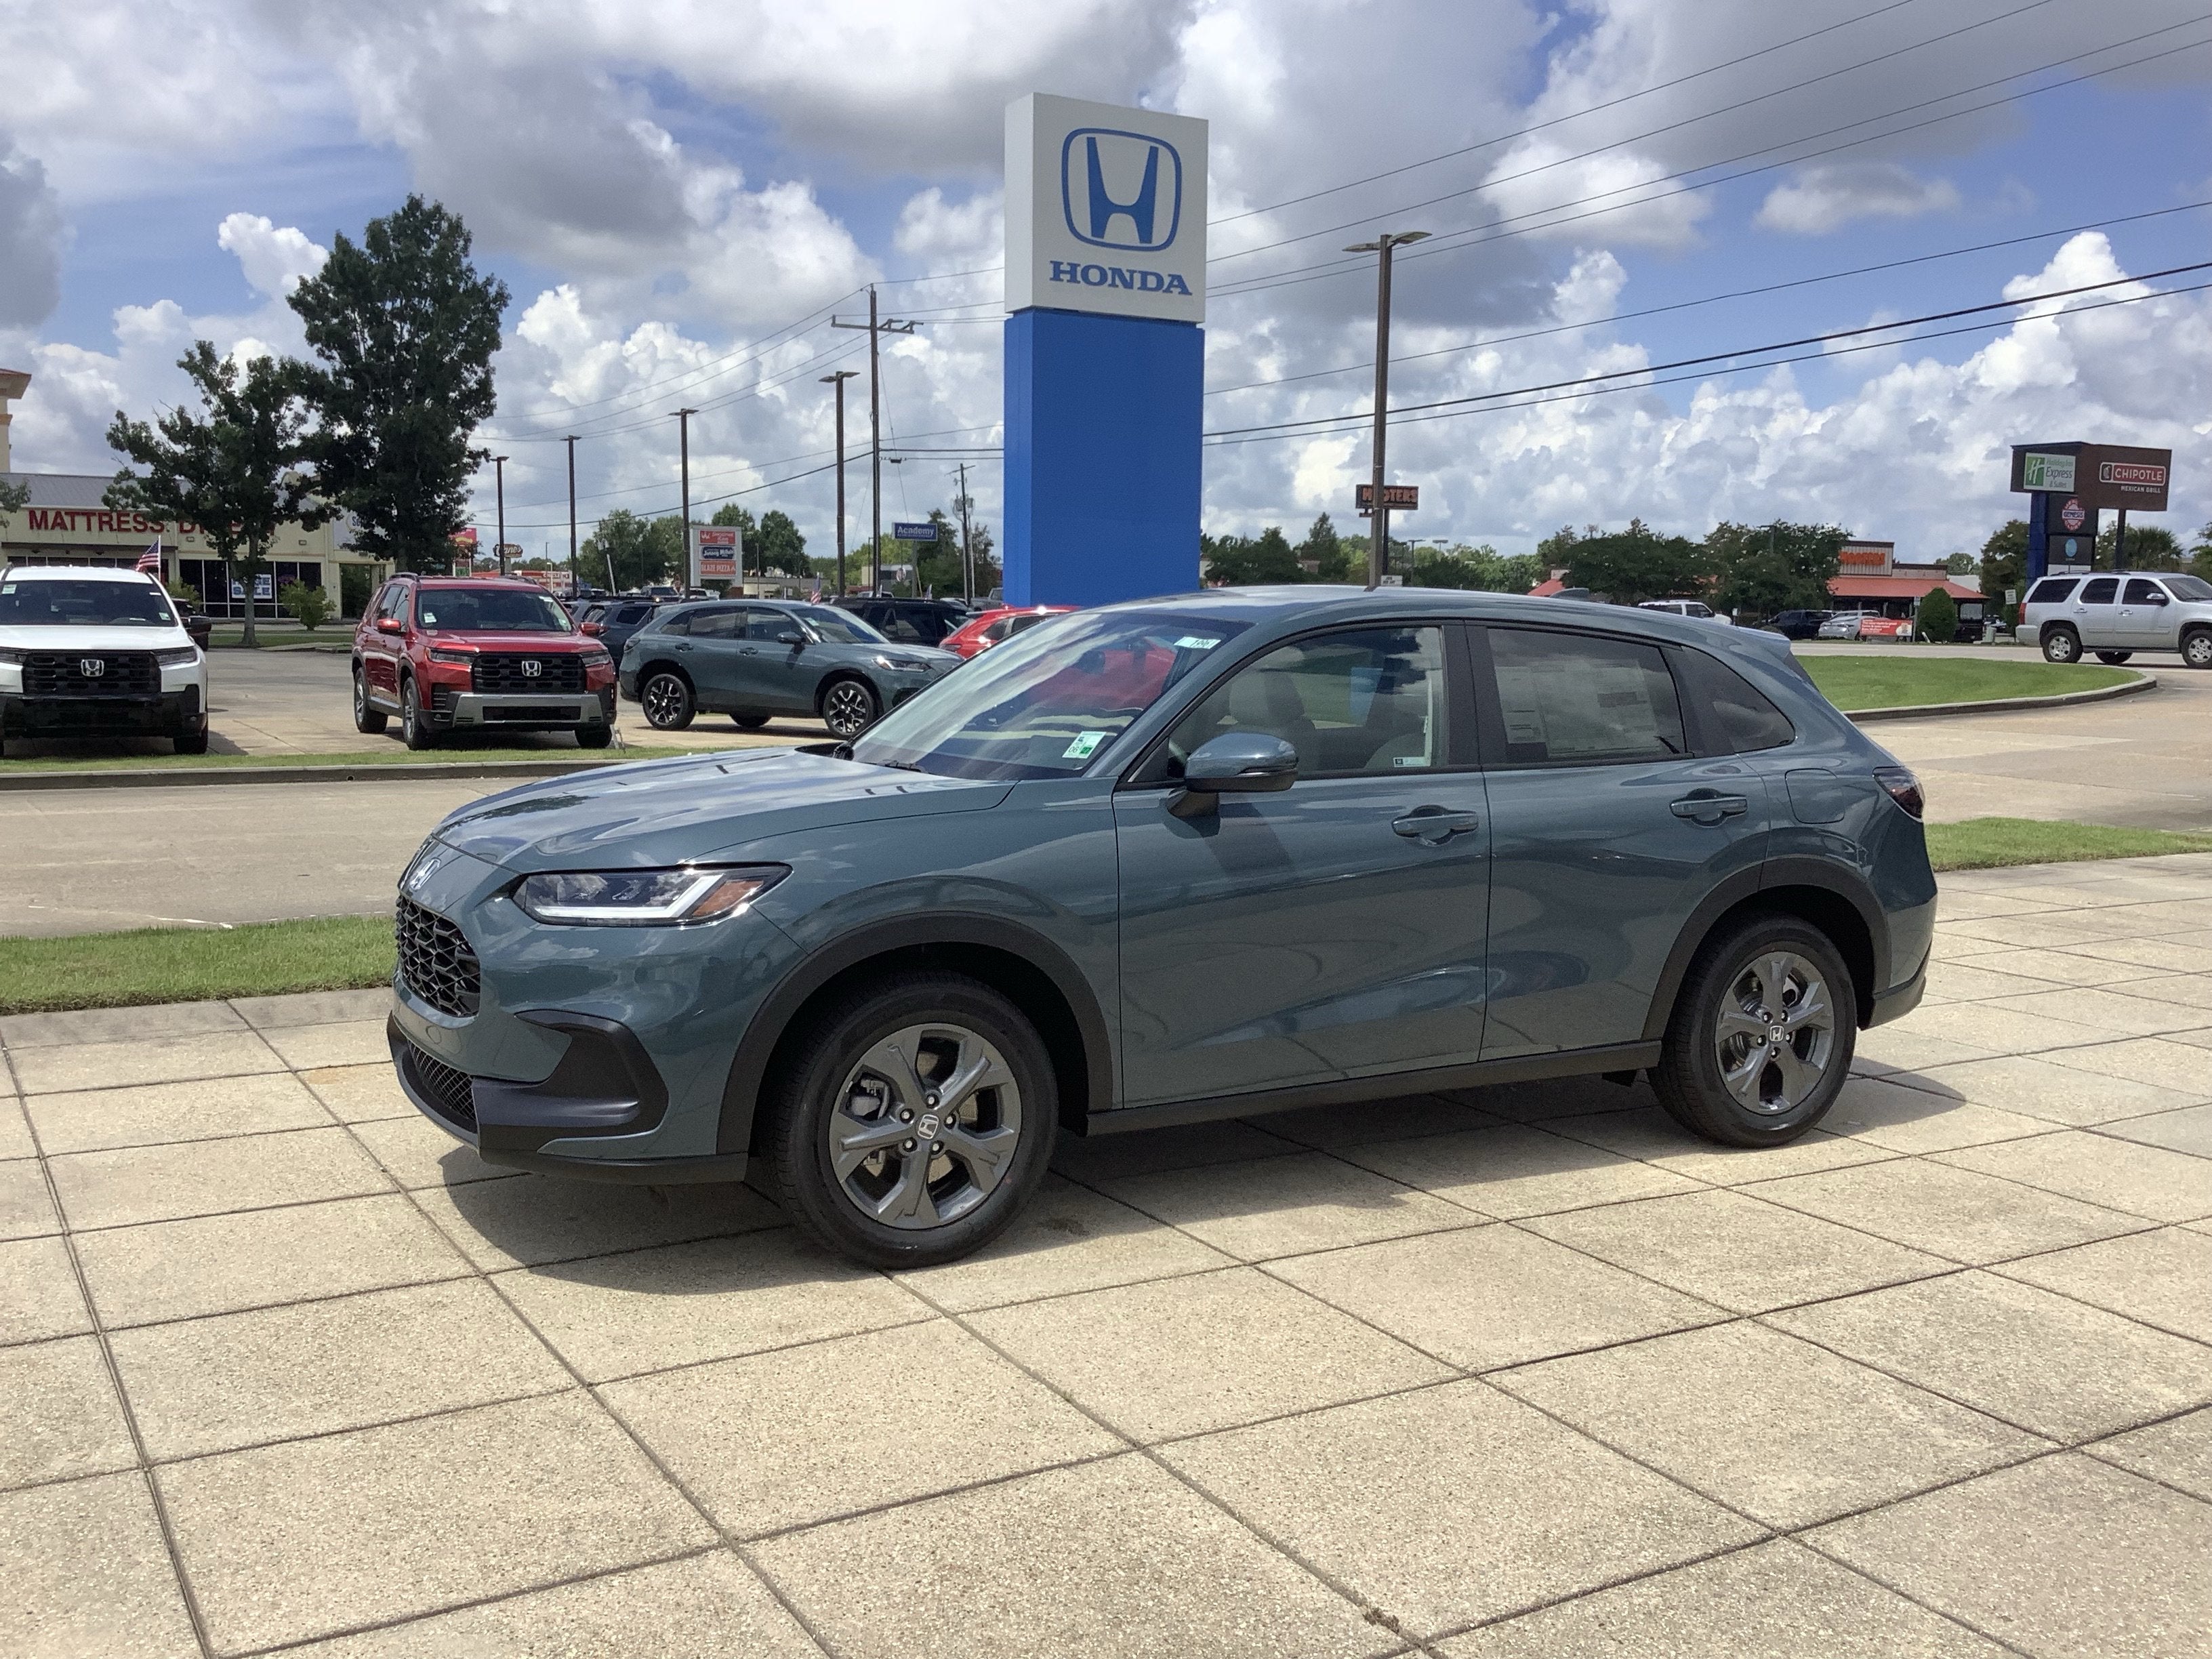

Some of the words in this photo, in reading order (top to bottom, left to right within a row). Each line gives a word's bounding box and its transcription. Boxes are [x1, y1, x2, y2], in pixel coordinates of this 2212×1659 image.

[1050, 260, 1193, 295] HONDA
[2045, 466, 2072, 480] Express
[2115, 468, 2163, 481] CHIPOTLE
[1362, 488, 1418, 502] HOTERS
[29, 510, 165, 533] MATTRESS
[897, 525, 935, 537] Academy
[233, 586, 270, 596] SLE
